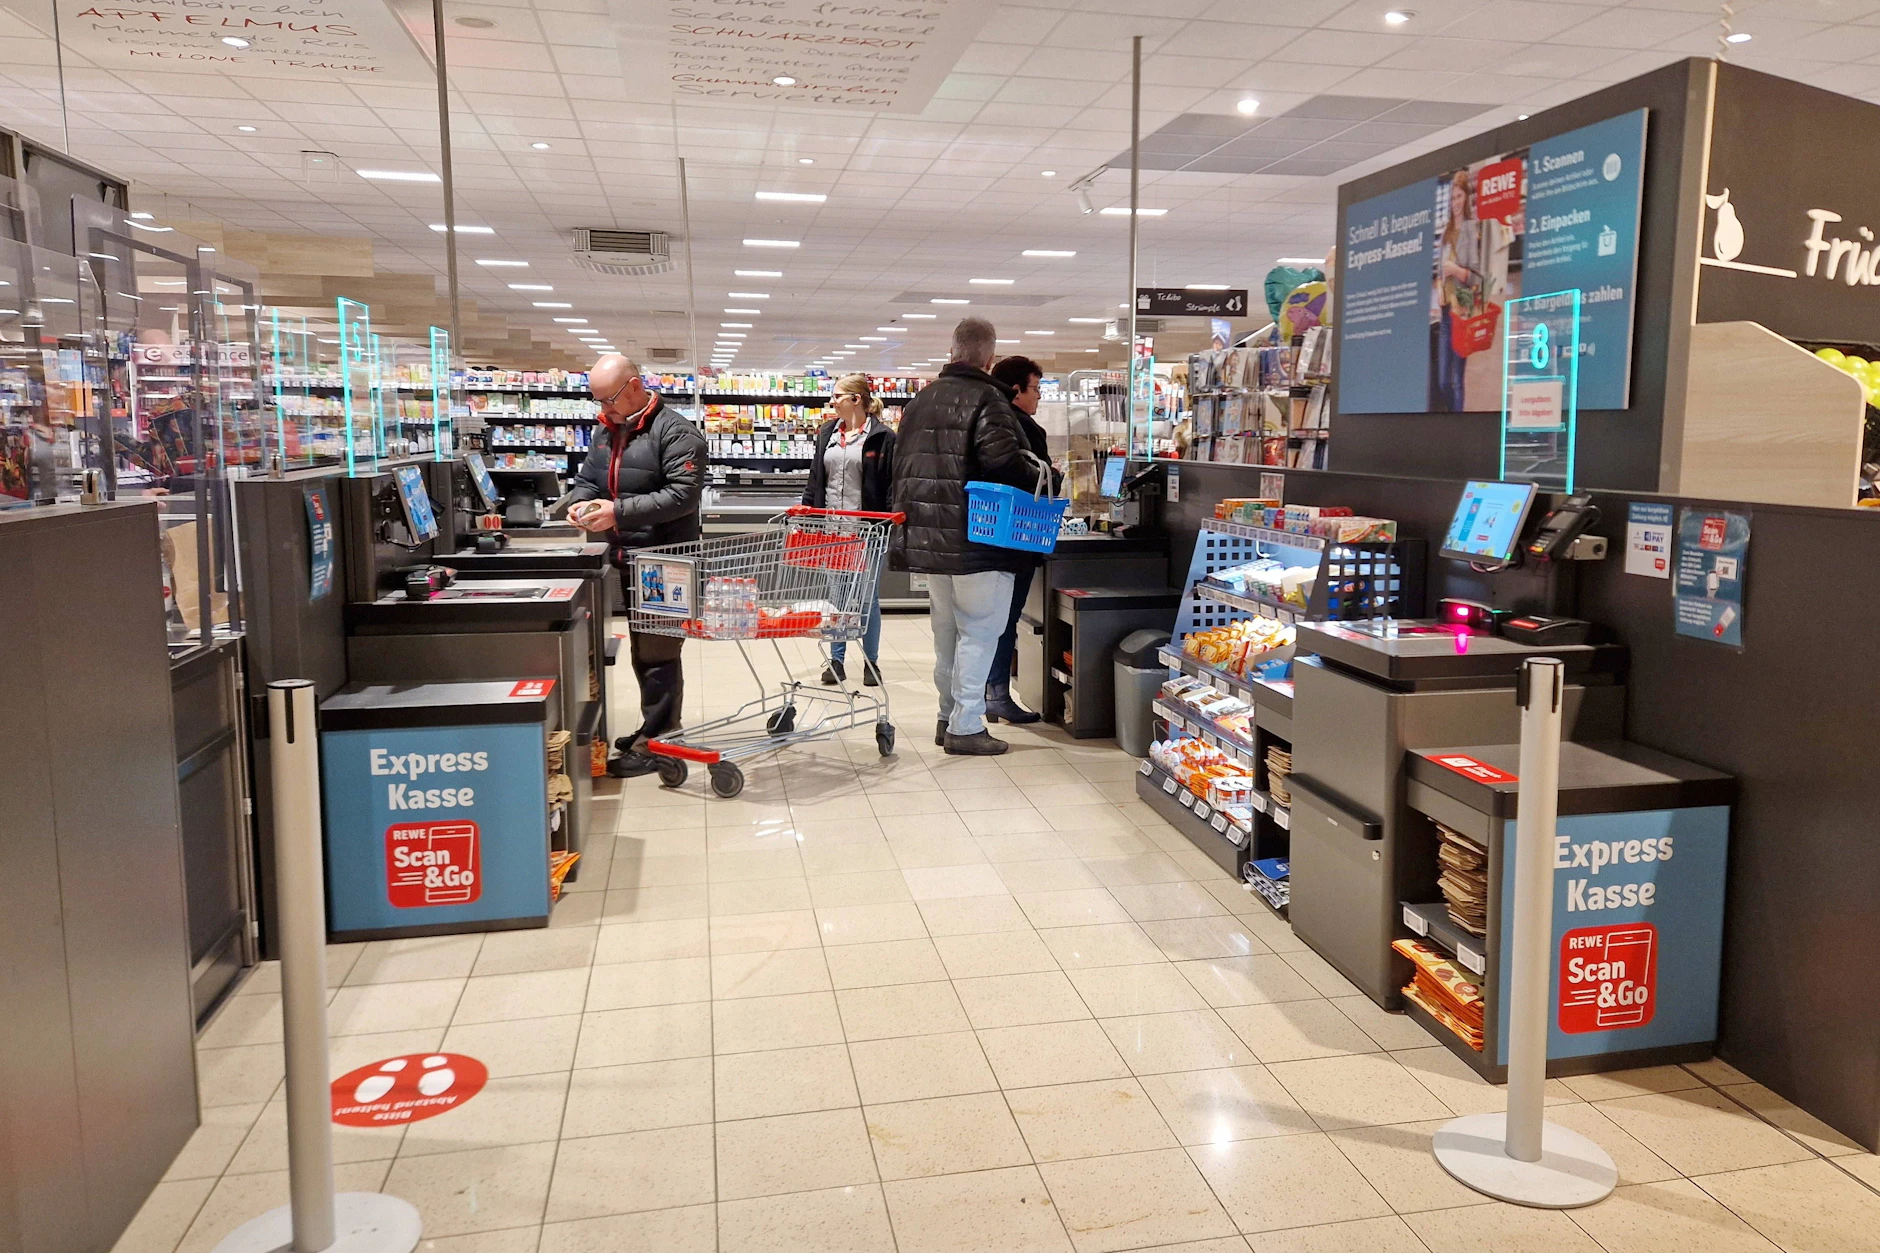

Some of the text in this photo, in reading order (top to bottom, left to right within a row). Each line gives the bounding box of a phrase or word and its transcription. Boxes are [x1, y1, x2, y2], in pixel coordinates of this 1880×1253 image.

[76, 7, 357, 36] APFELMUS
[668, 8, 934, 34] Schokostreusel
[92, 23, 369, 49] Marmelde Reis
[108, 37, 215, 48] Eiscreme
[667, 39, 785, 52] Shampoo
[130, 50, 385, 72] MELONE TRAUBE
[667, 52, 728, 61] Toast
[745, 57, 830, 66] Butter
[673, 85, 892, 106] Servietten
[1543, 150, 1585, 172] Scannen
[1482, 171, 1516, 196] REWE
[1349, 219, 1379, 245] Schnell
[1380, 216, 1389, 236] &
[1529, 208, 1591, 234] 2. Einpacken
[1156, 293, 1182, 301] Tchibo
[1589, 284, 1624, 304] zahlen
[1186, 302, 1221, 313] Strümpfe
[172, 350, 248, 361] esnce
[1531, 323, 1549, 369] 8
[370, 748, 489, 780] Express
[388, 784, 475, 810] Kasse
[393, 829, 427, 841] REWE
[393, 847, 450, 868] Scan
[1553, 836, 1674, 874] Express
[424, 865, 474, 888] &Go
[1567, 879, 1656, 912] Kasse
[1569, 935, 1603, 950] REWE
[1567, 957, 1626, 984] Scan
[1597, 980, 1649, 1008] &Go
[393, 1095, 458, 1110] Abstand
[372, 1110, 412, 1120] Bitte
